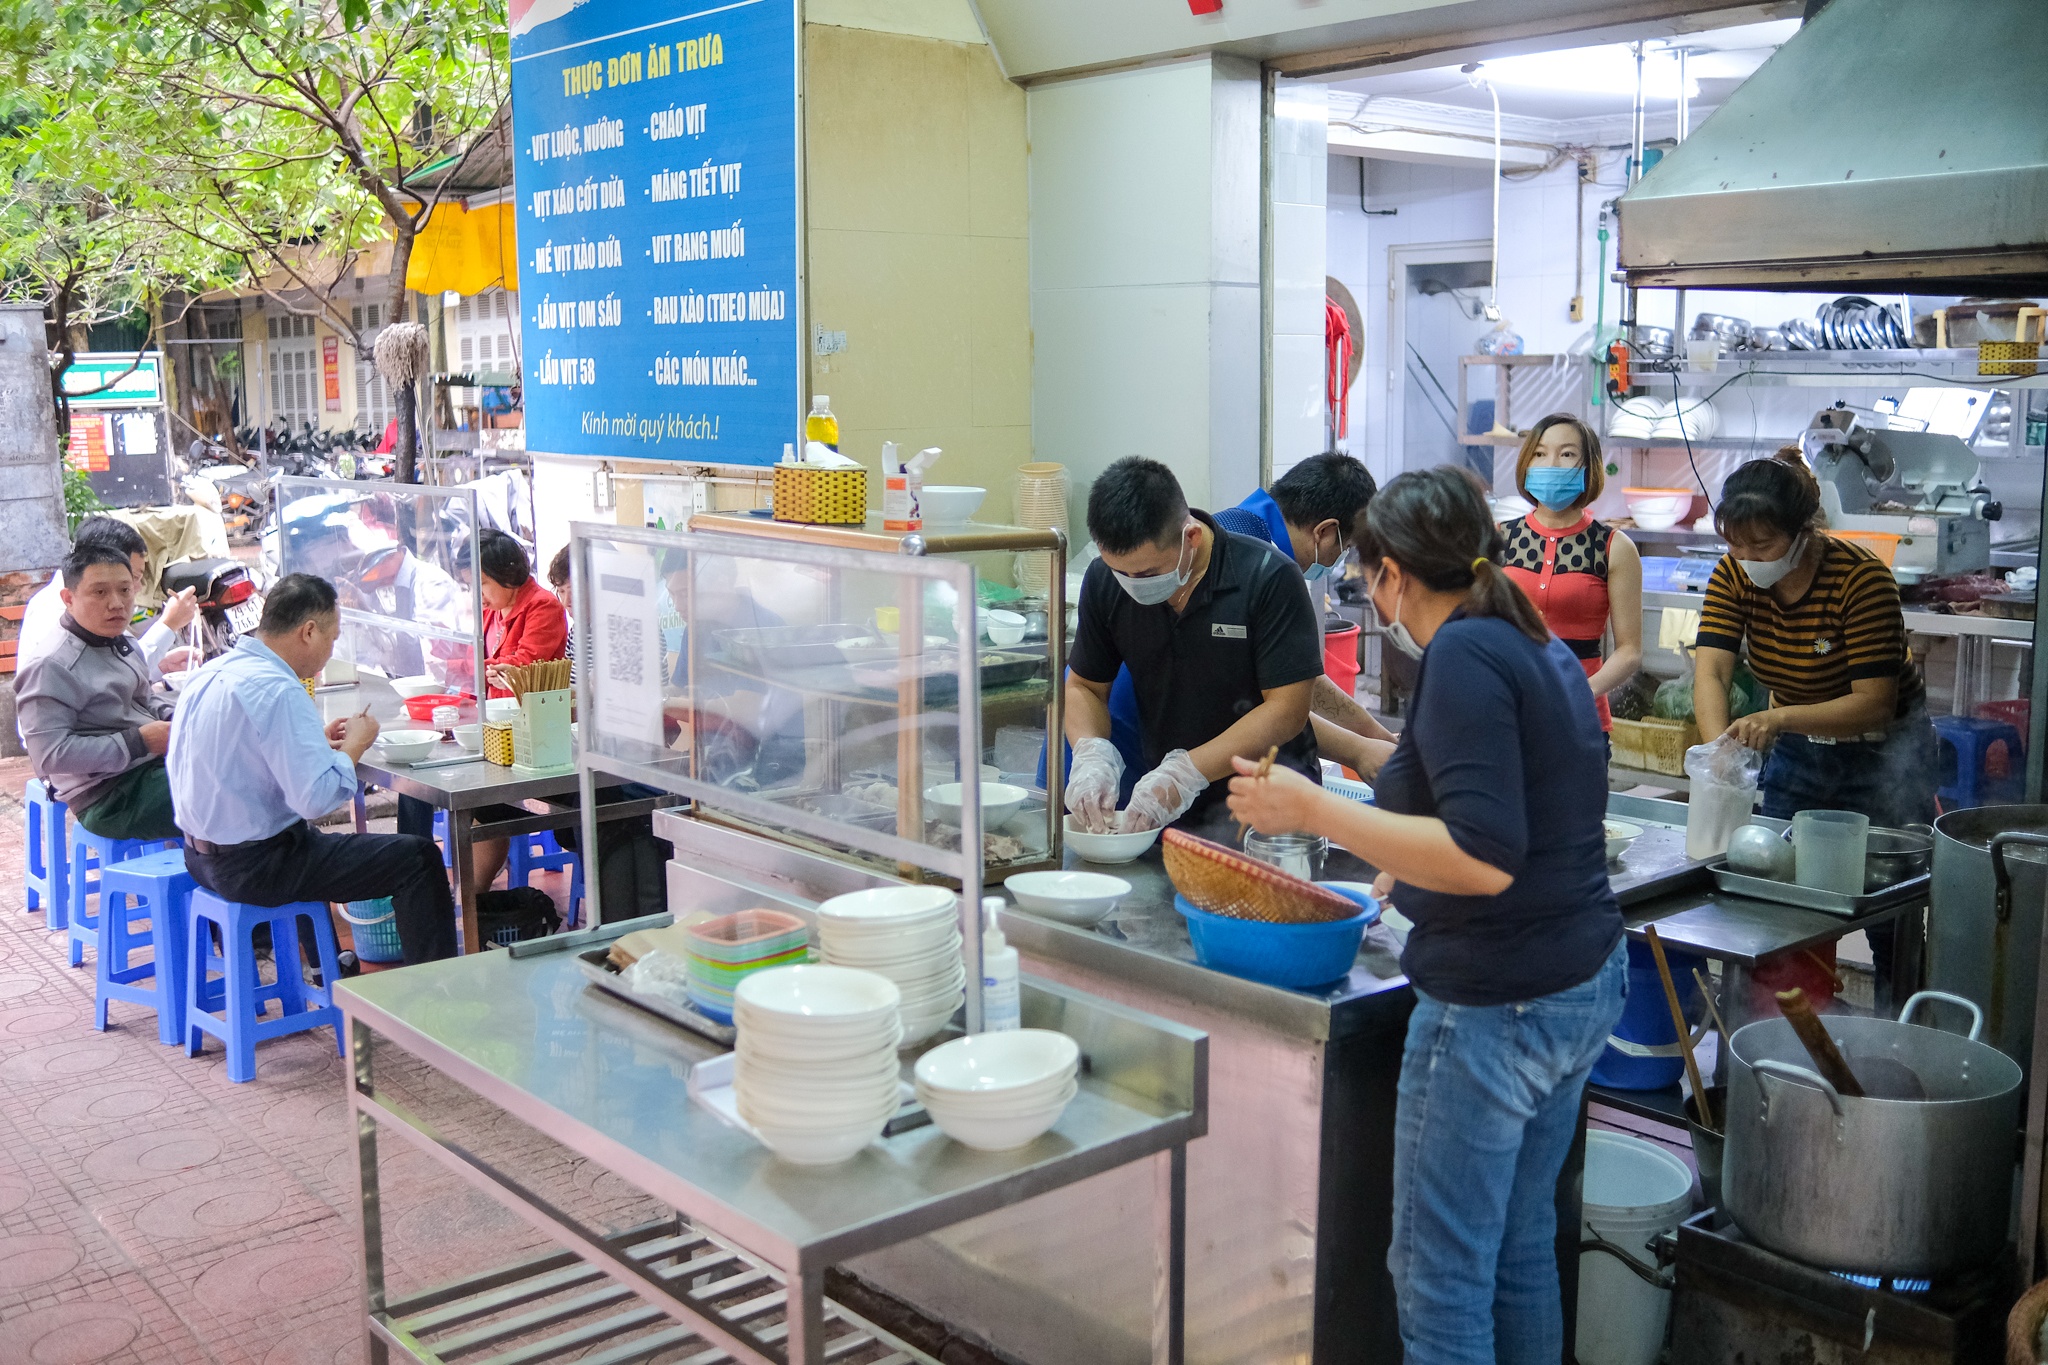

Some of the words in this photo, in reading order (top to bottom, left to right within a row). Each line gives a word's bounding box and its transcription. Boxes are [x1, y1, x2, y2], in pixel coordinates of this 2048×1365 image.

[562, 60, 602, 99] THỰC
[607, 51, 642, 88] ĐƠN
[647, 43, 671, 79] ĂN
[676, 32, 723, 73] TRƯA
[551, 123, 582, 161] LUỘC,
[584, 115, 624, 153] NƯỚNG
[685, 103, 707, 140] VỊT
[552, 181, 574, 215] XÁO
[576, 175, 599, 213] CỐT
[600, 173, 626, 209] DỪA
[689, 157, 718, 198] TIẾT
[719, 162, 742, 200] VỊT
[553, 244, 572, 278] VỊT
[573, 236, 596, 271] XÀO
[597, 233, 622, 269] DỨA
[673, 230, 708, 263] RANG
[710, 218, 745, 259] MUỐI
[558, 301, 577, 334] VỊT
[578, 300, 596, 328] OM
[597, 290, 622, 327] SẤU
[679, 287, 705, 324] XÀO
[706, 291, 746, 323] (THEO
[748, 283, 785, 322] MÙA)
[560, 358, 578, 391] VỊT
[580, 357, 595, 385] 58
[681, 349, 710, 386] MÓN
[712, 349, 758, 386] KHÁC...
[581, 410, 609, 435] Kính
[611, 411, 637, 437] mời
[639, 412, 665, 444] quý
